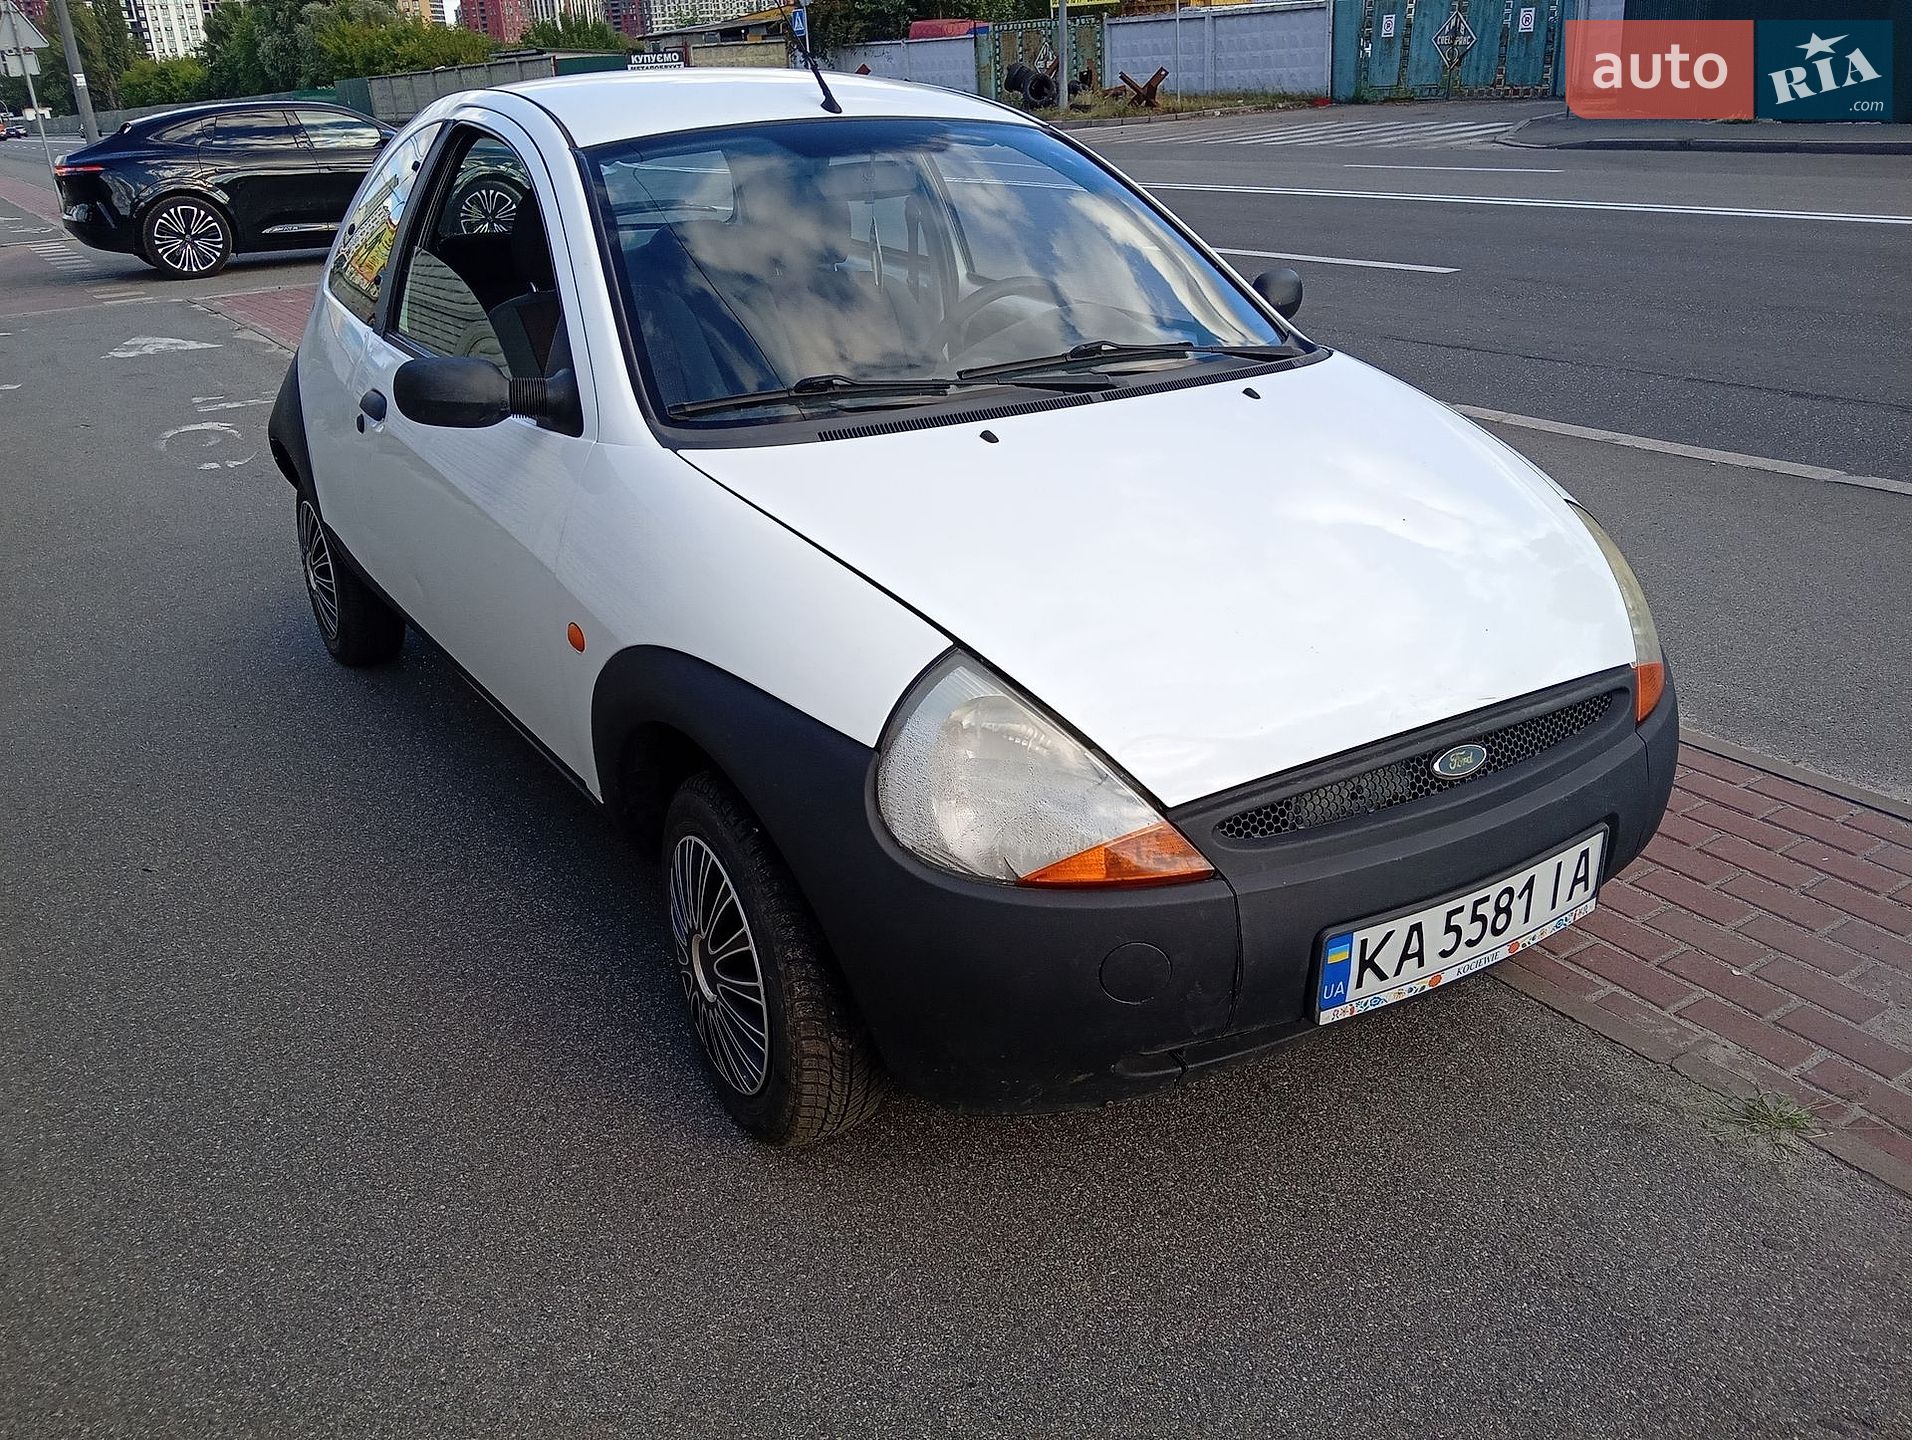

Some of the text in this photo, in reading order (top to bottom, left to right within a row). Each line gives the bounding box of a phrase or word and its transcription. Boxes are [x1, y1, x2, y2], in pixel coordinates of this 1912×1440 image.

[631, 52, 679, 64] КУПУЄМО
[1449, 750, 1473, 770] Ford
[1355, 847, 1590, 990] KA 5581 IA
[1456, 951, 1500, 976] KOCIEWIE
[1323, 981, 1345, 999] UA
